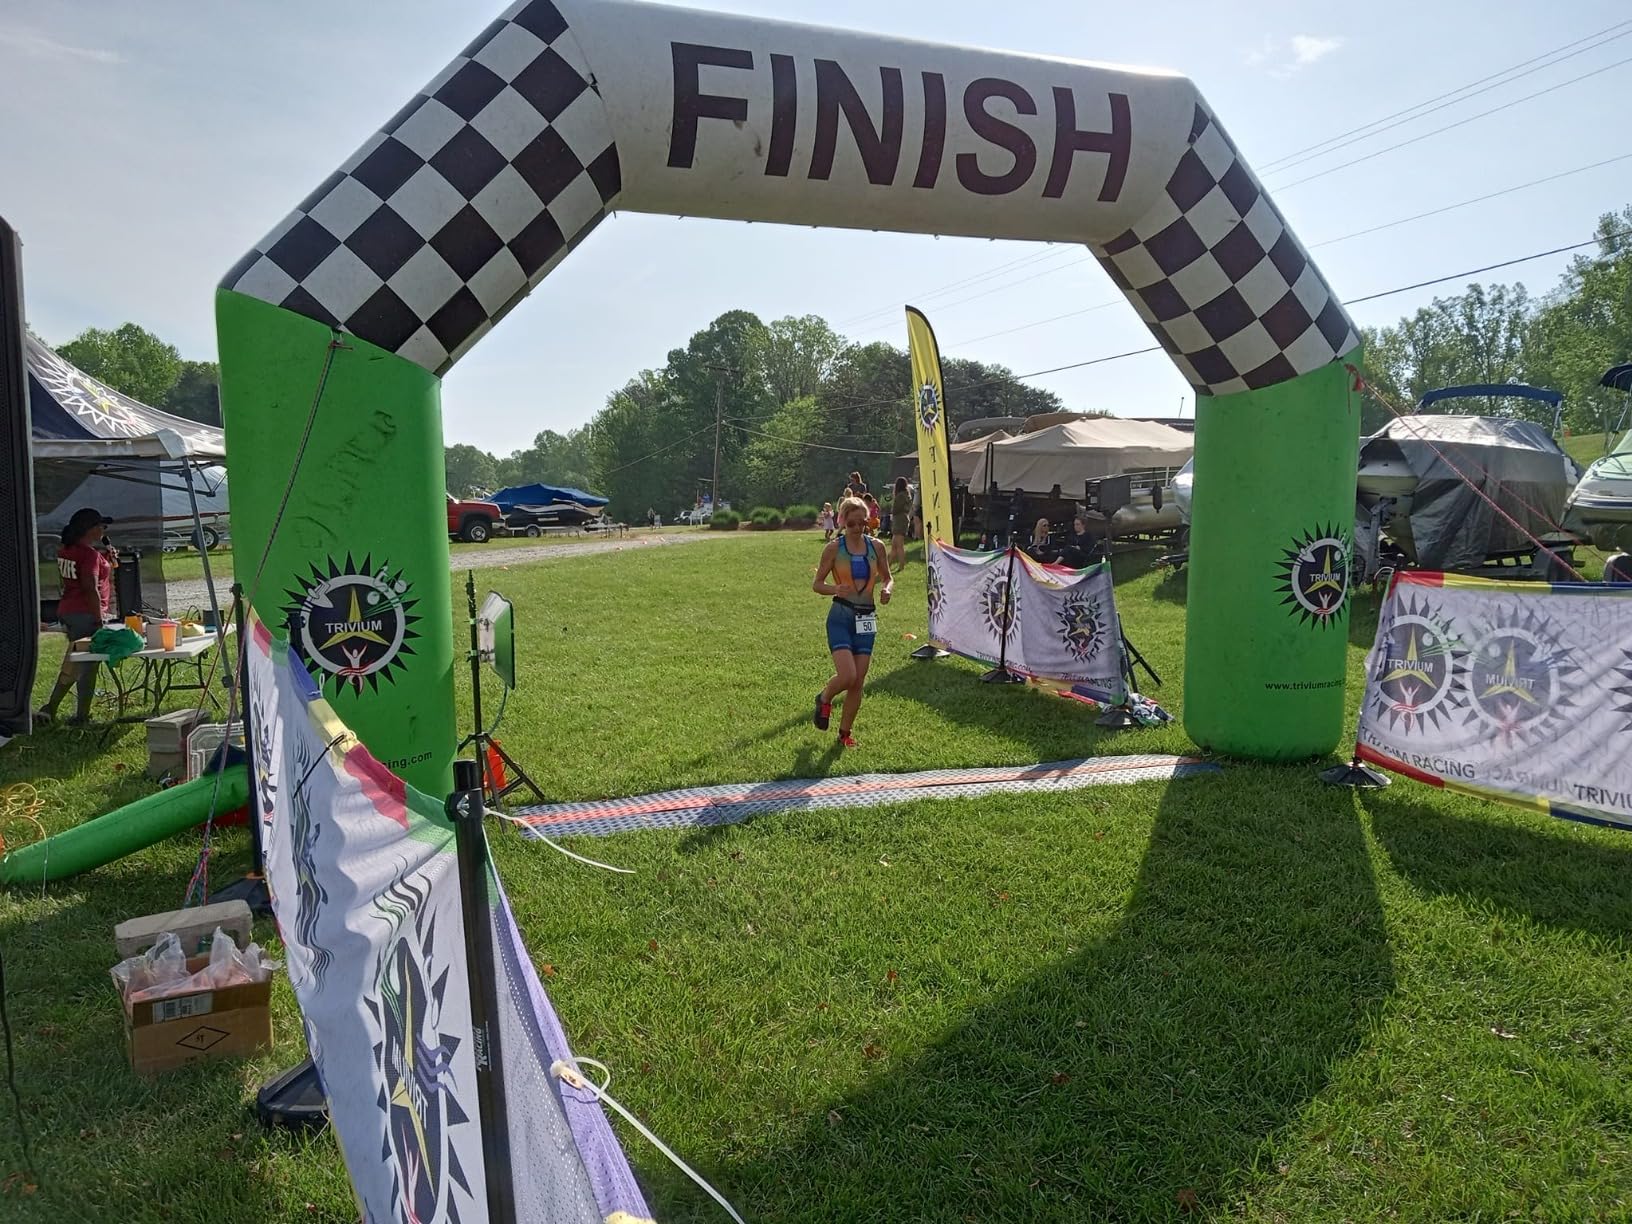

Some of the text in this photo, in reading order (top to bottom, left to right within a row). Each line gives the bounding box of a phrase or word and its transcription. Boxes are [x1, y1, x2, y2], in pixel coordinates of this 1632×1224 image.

[667, 41, 1132, 203] FINISH
[1309, 572, 1341, 583] TRIVIUM
[324, 619, 383, 634] TRIVIUM
[862, 621, 873, 632] 50
[1387, 658, 1434, 673] TRIVIUM
[1412, 754, 1476, 779] RACING
